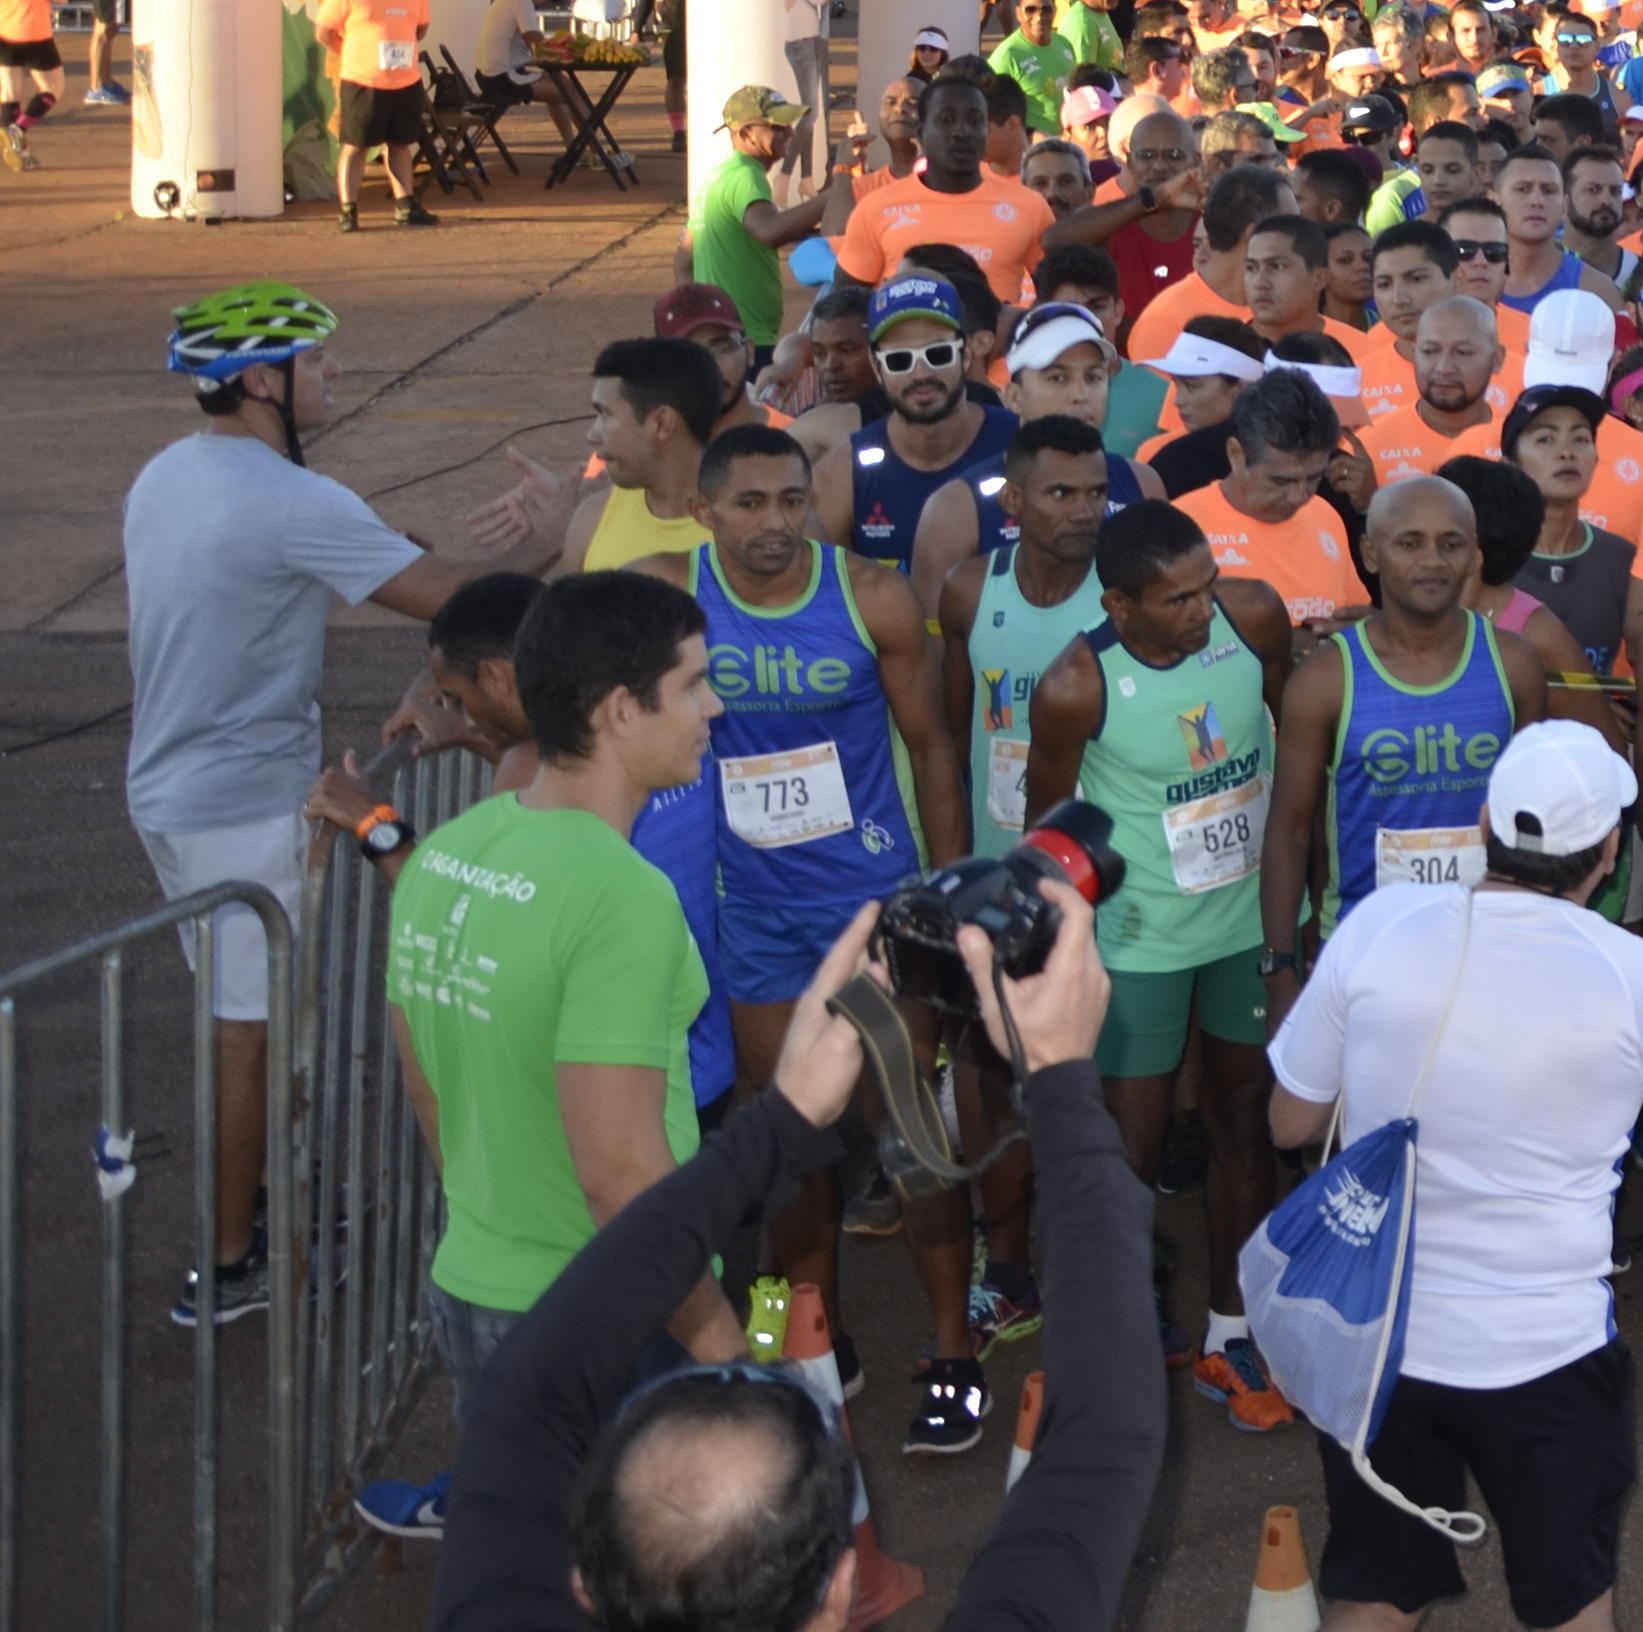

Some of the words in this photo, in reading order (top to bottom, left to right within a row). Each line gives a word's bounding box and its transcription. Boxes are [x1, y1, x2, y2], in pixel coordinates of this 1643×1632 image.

[754, 776, 810, 814] 773
[1203, 812, 1251, 854] 528
[1410, 855, 1460, 885] 304
